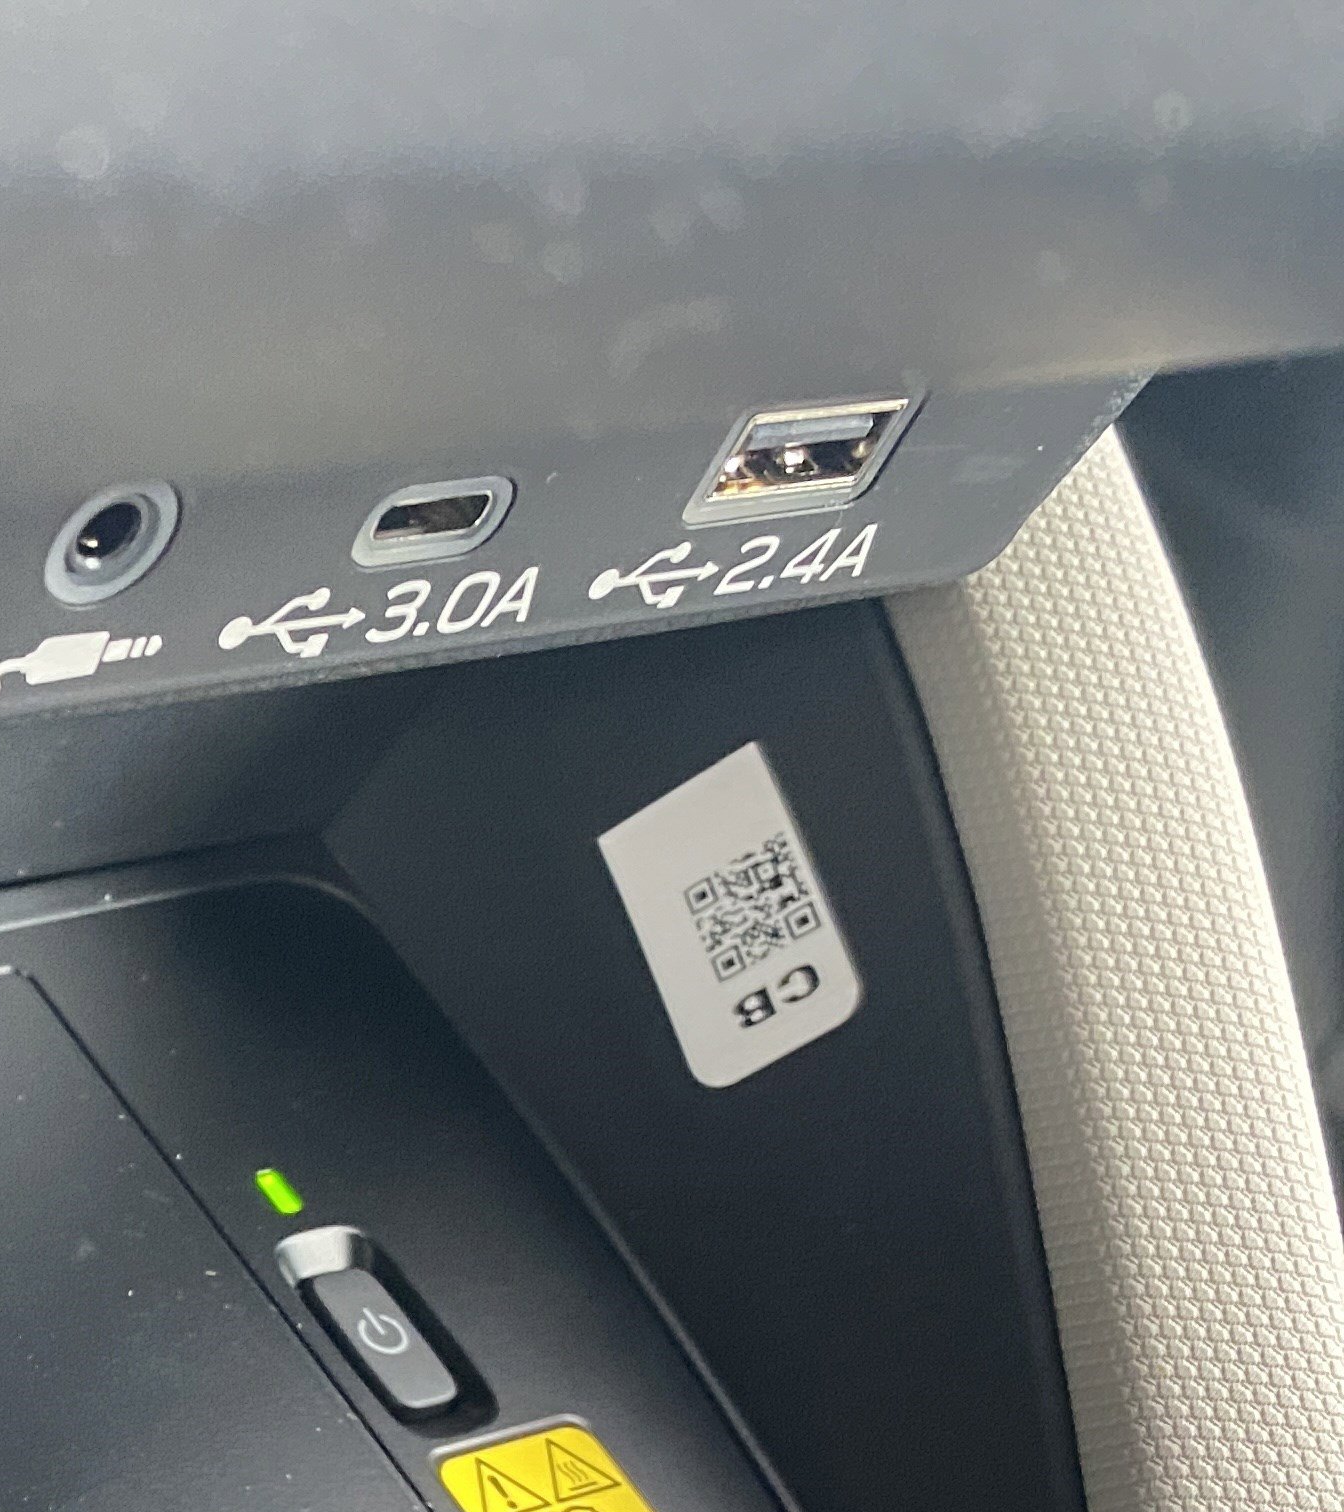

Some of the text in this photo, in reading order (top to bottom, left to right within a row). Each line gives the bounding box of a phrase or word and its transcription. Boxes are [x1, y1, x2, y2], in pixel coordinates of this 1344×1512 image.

[713, 523, 879, 596] 2.4A
[364, 565, 541, 643] 3.0A
[733, 964, 820, 1028] CB
